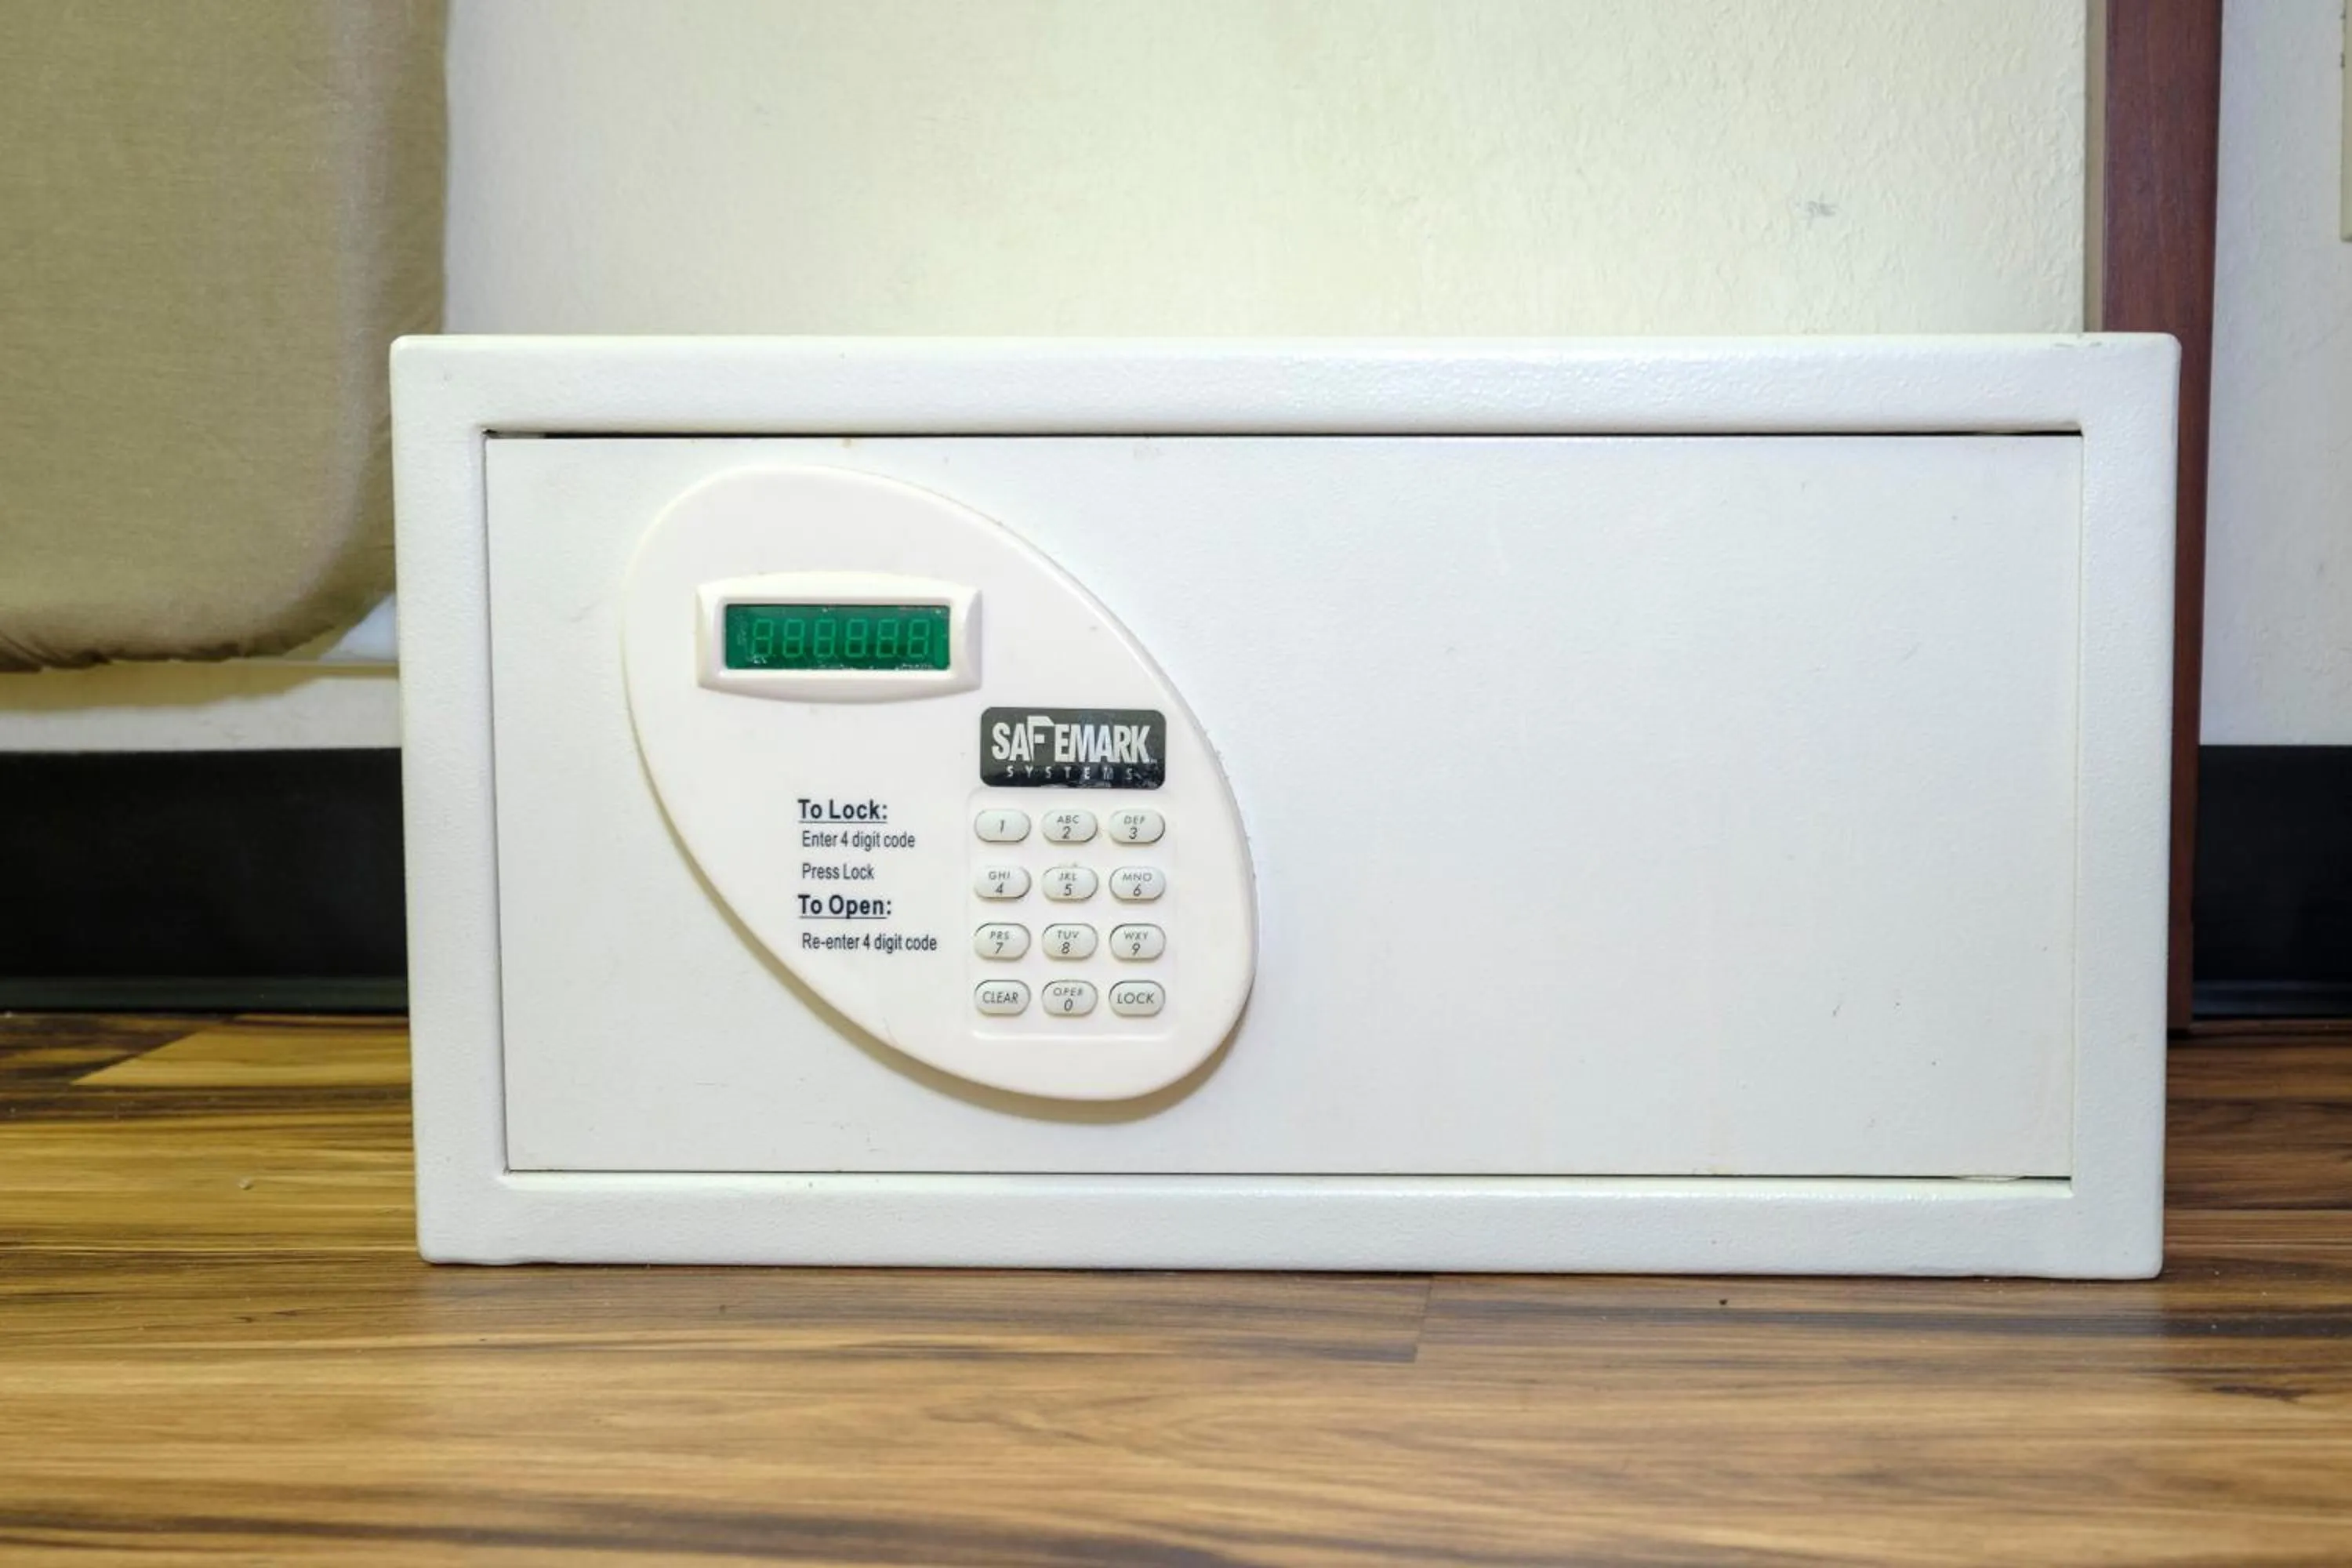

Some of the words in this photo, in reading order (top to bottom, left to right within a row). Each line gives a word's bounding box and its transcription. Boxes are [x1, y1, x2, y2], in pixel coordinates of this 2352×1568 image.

[991, 715, 1151, 764] SAFEMARK
[1007, 764, 1134, 780] SYSTEMS
[797, 798, 822, 819] To
[829, 798, 887, 820] Lock:
[1057, 815, 1080, 824] ABC
[1123, 815, 1145, 824] DEF
[999, 819, 1006, 833] 1
[1062, 826, 1071, 840] 2
[1128, 827, 1138, 840] 3
[801, 830, 837, 848] Enter
[840, 831, 848, 847] 4
[852, 830, 880, 851] digit
[884, 831, 916, 848] code
[801, 862, 840, 880] Press
[843, 862, 875, 880] Lock
[988, 871, 1011, 880] GHI
[1058, 872, 1078, 881] JKL
[1122, 873, 1152, 881] MNO
[995, 882, 1004, 894] 4
[1064, 884, 1073, 896] 5
[1133, 884, 1142, 897] 6
[797, 894, 822, 914] To
[829, 894, 892, 919] Open:
[989, 931, 1011, 940] PRS
[1057, 930, 1080, 940] TUV
[1123, 931, 1149, 940] WXY
[801, 932, 860, 950] Re-enter
[862, 933, 870, 949] 4
[874, 933, 902, 953] digit
[906, 934, 938, 951] code
[994, 942, 1004, 954] 7
[1061, 942, 1070, 954] 8
[1131, 942, 1141, 956] 9
[982, 991, 1019, 1004] CLEAR
[1053, 988, 1083, 997] OPER
[1116, 993, 1155, 1004] LOCK
[1064, 998, 1073, 1011] 0
